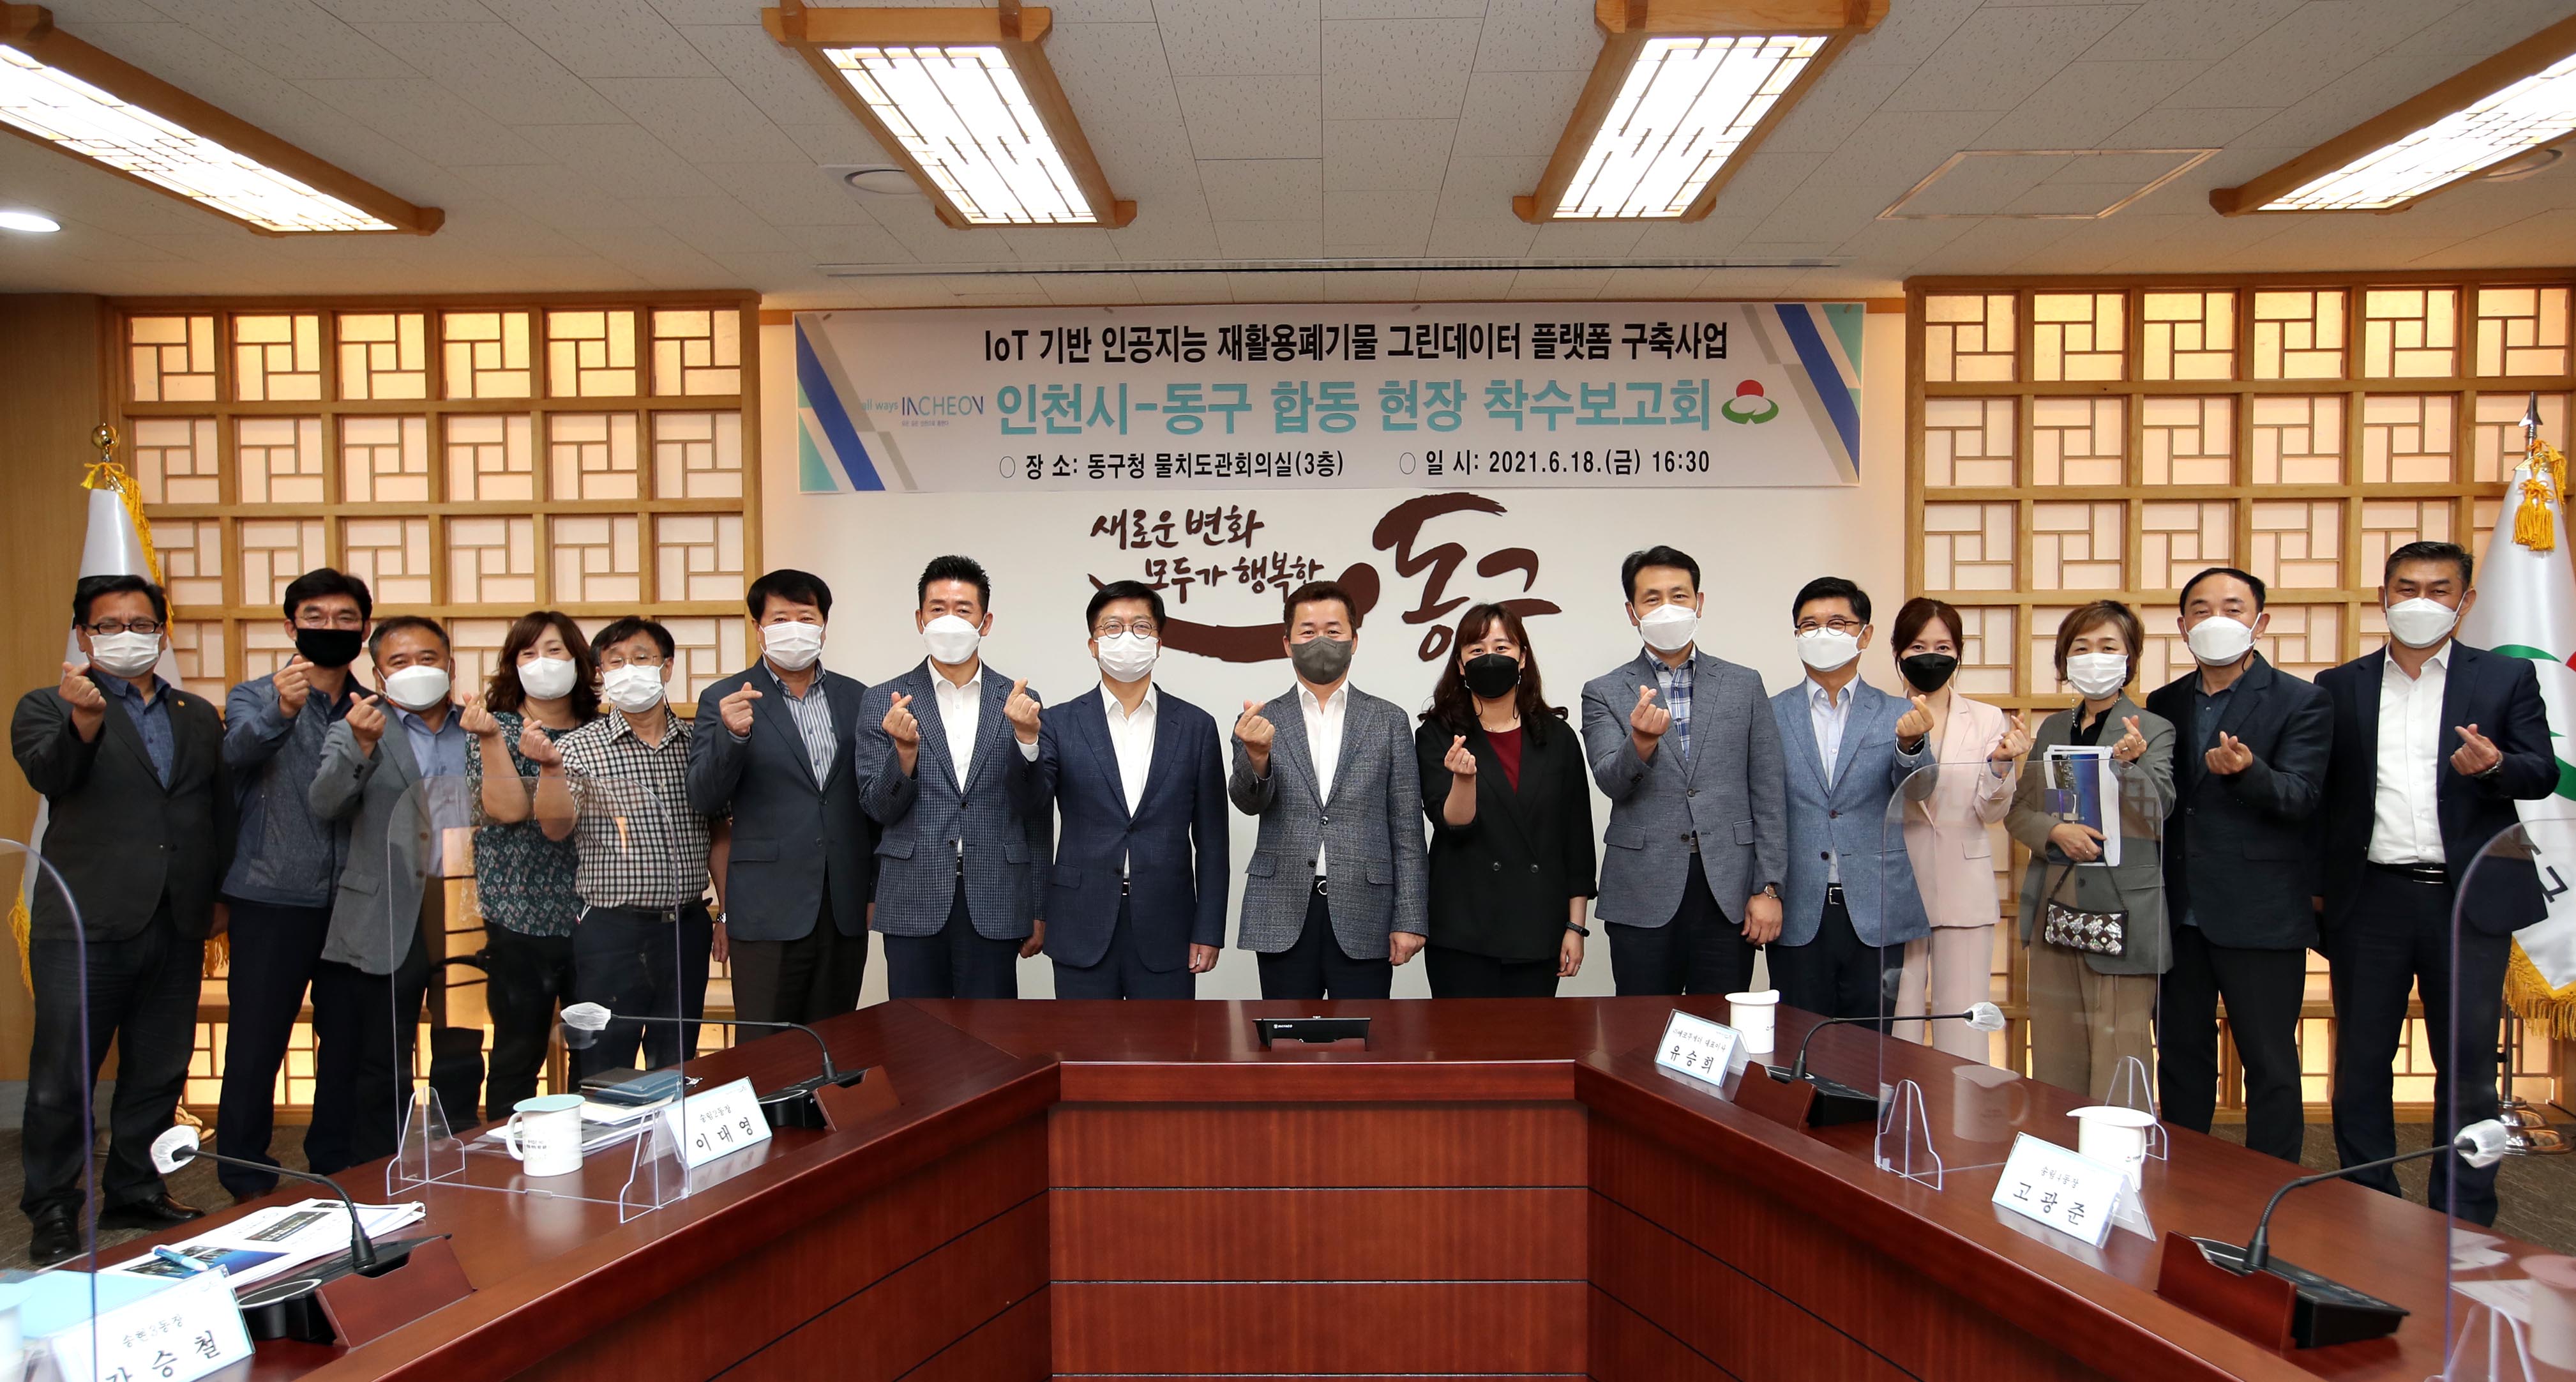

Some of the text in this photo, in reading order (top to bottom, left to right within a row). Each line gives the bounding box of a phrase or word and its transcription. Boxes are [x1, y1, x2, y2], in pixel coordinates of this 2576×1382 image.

[985, 321, 1728, 365] IoT 기반 인공지능 재활용폐기물 그린데이터 플랫폼 구축사업
[875, 401, 898, 413] ways
[901, 395, 984, 416] INCHEON
[996, 377, 1710, 436] 인천시-동구 합동 현장 착수보고회
[1087, 453, 1145, 480] 동구청
[1154, 451, 1343, 478] 물치도관회의실(3층)
[1489, 448, 1641, 475] 2021.6.18.(금)
[1652, 450, 1709, 473] 16:30
[1090, 505, 1265, 550] 새로운 변화
[1144, 556, 1228, 604] 모두가
[1372, 492, 1562, 662] 동구
